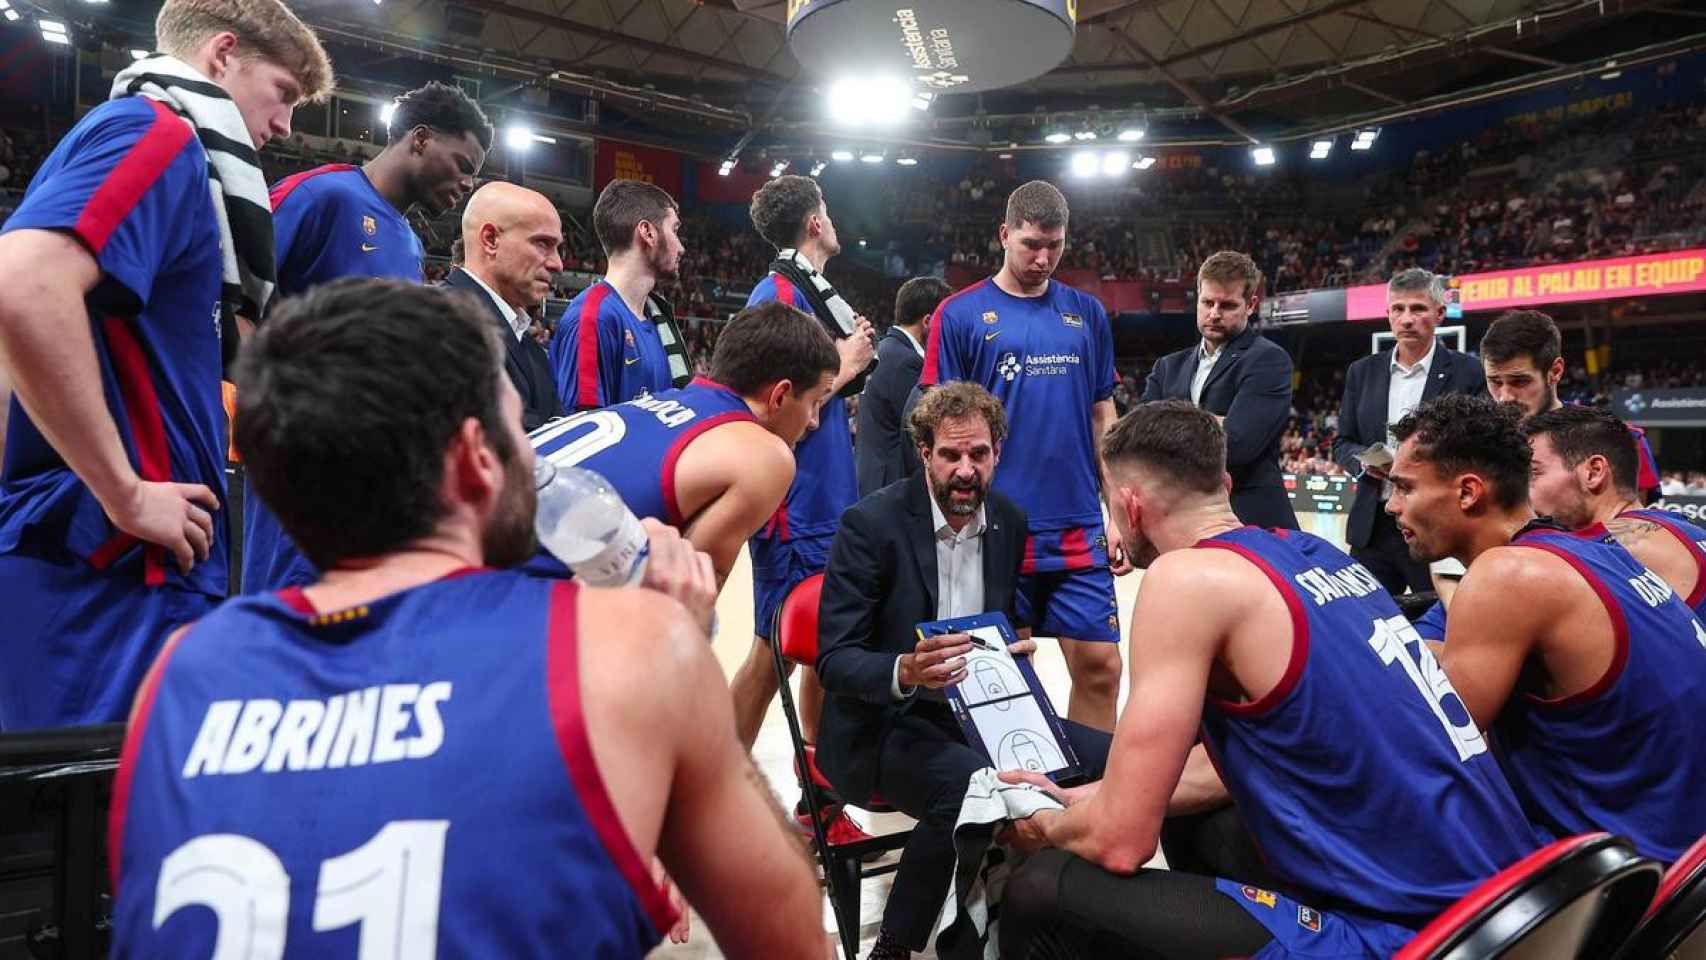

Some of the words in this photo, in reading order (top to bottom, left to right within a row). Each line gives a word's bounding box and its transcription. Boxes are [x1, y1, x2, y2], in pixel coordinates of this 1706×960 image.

[1538, 268, 1601, 296] PALAU
[182, 681, 452, 779] ABRINES
[152, 820, 450, 960] 21
